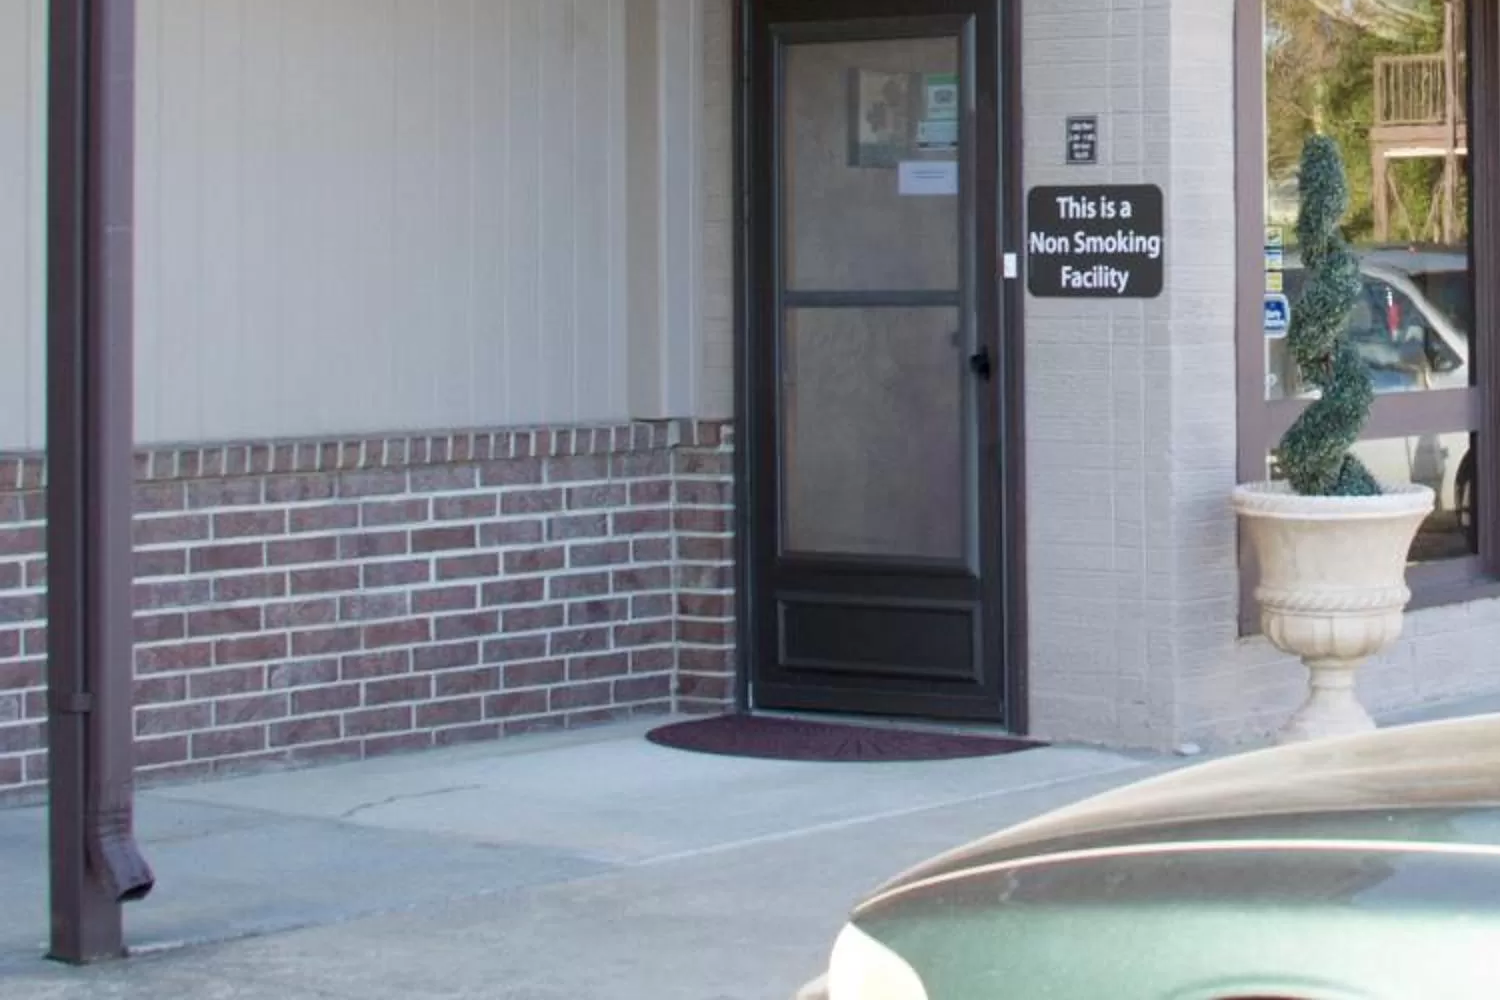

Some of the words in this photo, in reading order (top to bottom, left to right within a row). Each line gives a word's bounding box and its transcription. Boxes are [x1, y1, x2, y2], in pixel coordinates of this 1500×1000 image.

[1056, 196, 1096, 219] This
[1100, 196, 1116, 219] is
[1119, 200, 1132, 218] a
[1029, 231, 1070, 254] Non
[1072, 229, 1161, 259] Smoking
[1061, 264, 1129, 294] Facility
